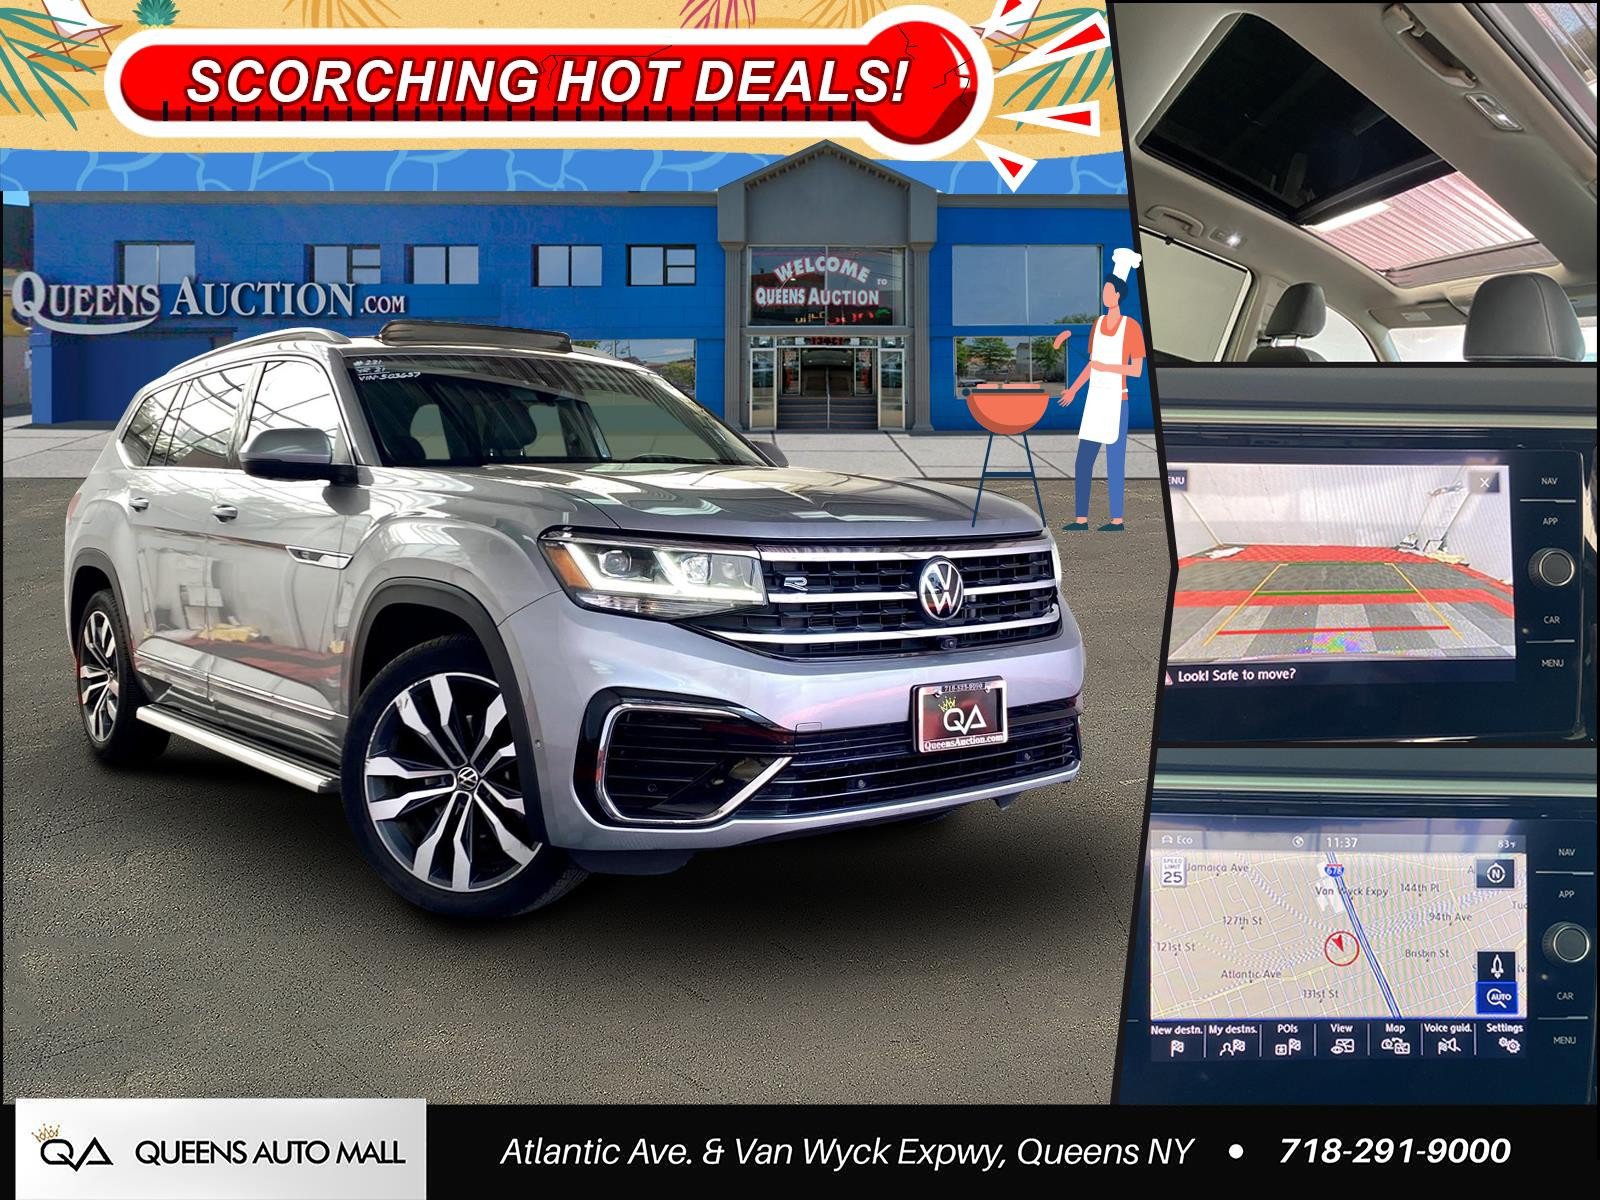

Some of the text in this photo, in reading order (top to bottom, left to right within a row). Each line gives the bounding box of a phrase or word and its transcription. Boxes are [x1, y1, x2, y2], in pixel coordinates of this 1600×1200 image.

[773, 256, 872, 283] WELCOME
[755, 286, 880, 307] QUEENS AUCTION
[12, 271, 161, 335] QUEENS
[1541, 477, 1559, 486] NAV
[1542, 517, 1559, 526] APP
[1543, 615, 1561, 625] CAR
[1542, 658, 1565, 668] MENU
[1178, 668, 1296, 682] Look! Safe to move?
[924, 734, 1004, 751] QueensAuction.com
[1176, 835, 1193, 845] Eco
[1326, 837, 1359, 848] 11:37
[1558, 848, 1576, 857] NAV
[1187, 863, 1249, 872] Jamaica Ave
[1163, 871, 1183, 883] 25
[1315, 887, 1334, 895] Van
[1365, 887, 1389, 898] Expy
[1400, 883, 1425, 893] 144th
[1558, 890, 1575, 899] APP
[1222, 916, 1263, 926] 127th St
[1429, 912, 1473, 921] 94th Ave
[1156, 942, 1196, 951] 121st St
[1405, 949, 1450, 959] Brisbin St
[1221, 969, 1282, 979] Atlantic Ave
[1302, 989, 1339, 999] 131st St
[1491, 993, 1512, 1001] AUTO
[1556, 992, 1574, 1000] CAR
[1151, 1025, 1203, 1035] New destn.
[1208, 1025, 1258, 1036] My destns.
[1277, 1024, 1298, 1034] POIs
[1330, 1023, 1353, 1033] View
[1385, 1023, 1406, 1034] Map
[1424, 1023, 1472, 1034] Voice guid.
[1486, 1023, 1524, 1034] Settings
[1553, 1036, 1577, 1045] MENU
